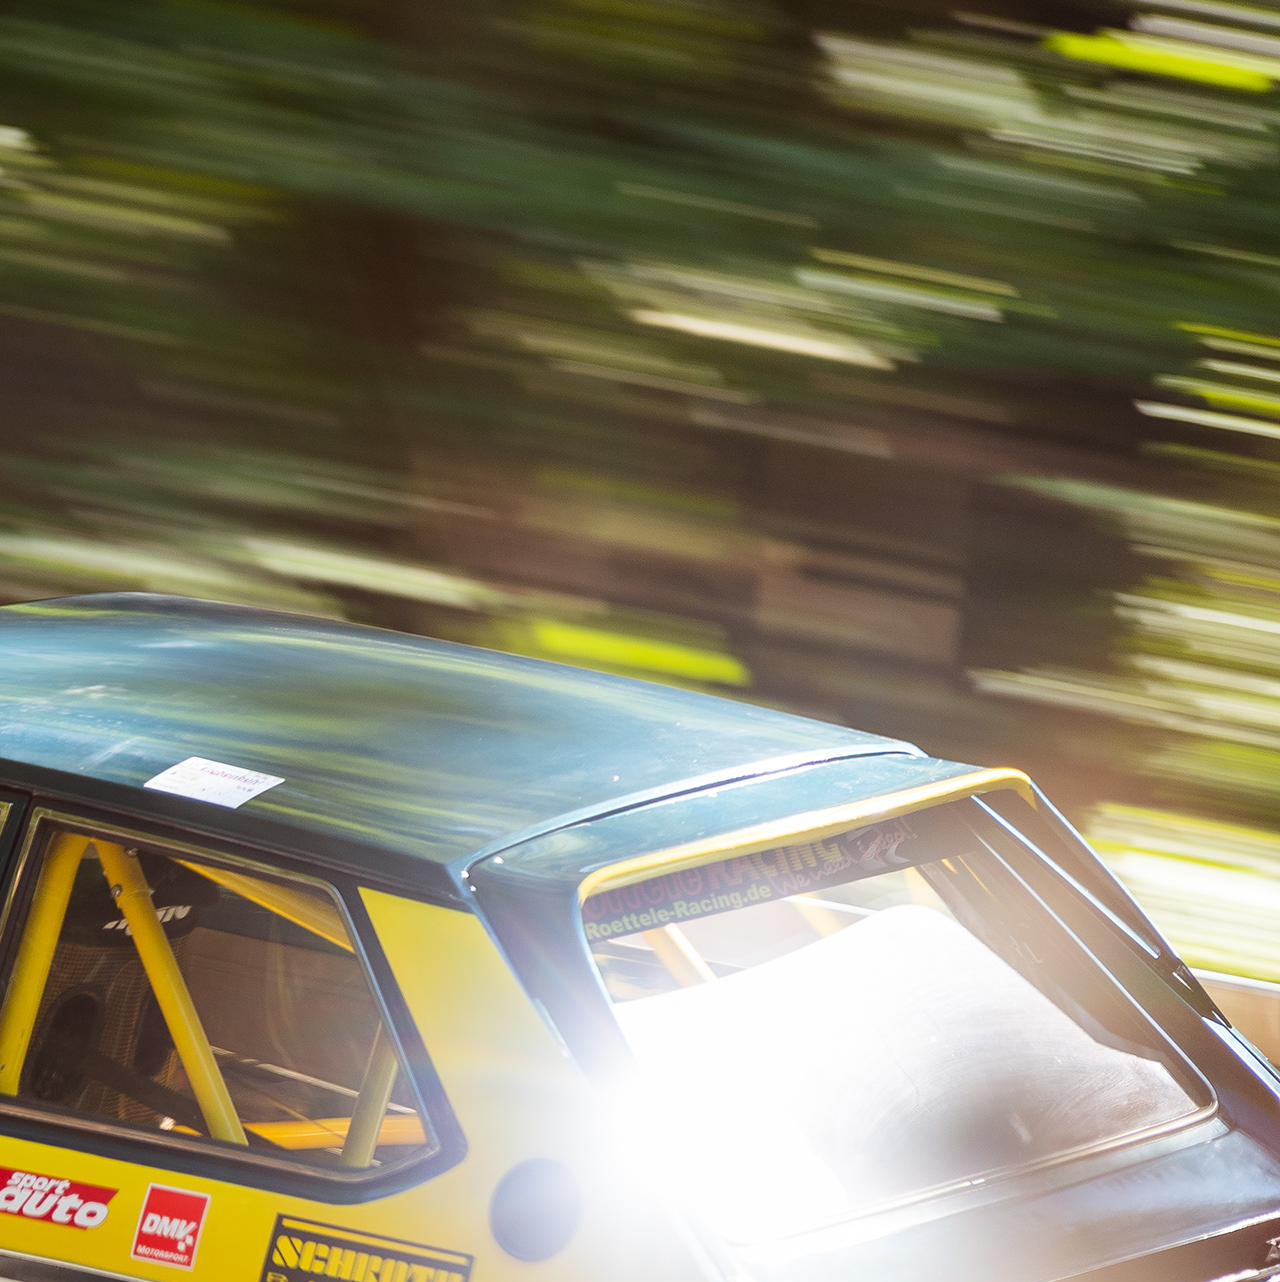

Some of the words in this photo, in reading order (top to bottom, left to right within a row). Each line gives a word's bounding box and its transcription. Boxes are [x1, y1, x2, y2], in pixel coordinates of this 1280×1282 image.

[586, 884, 772, 940] Roettele-Racing.de
[7, 1170, 72, 1195] sport
[141, 1212, 197, 1240] DMV
[136, 1244, 190, 1264] MOTORSPORT
